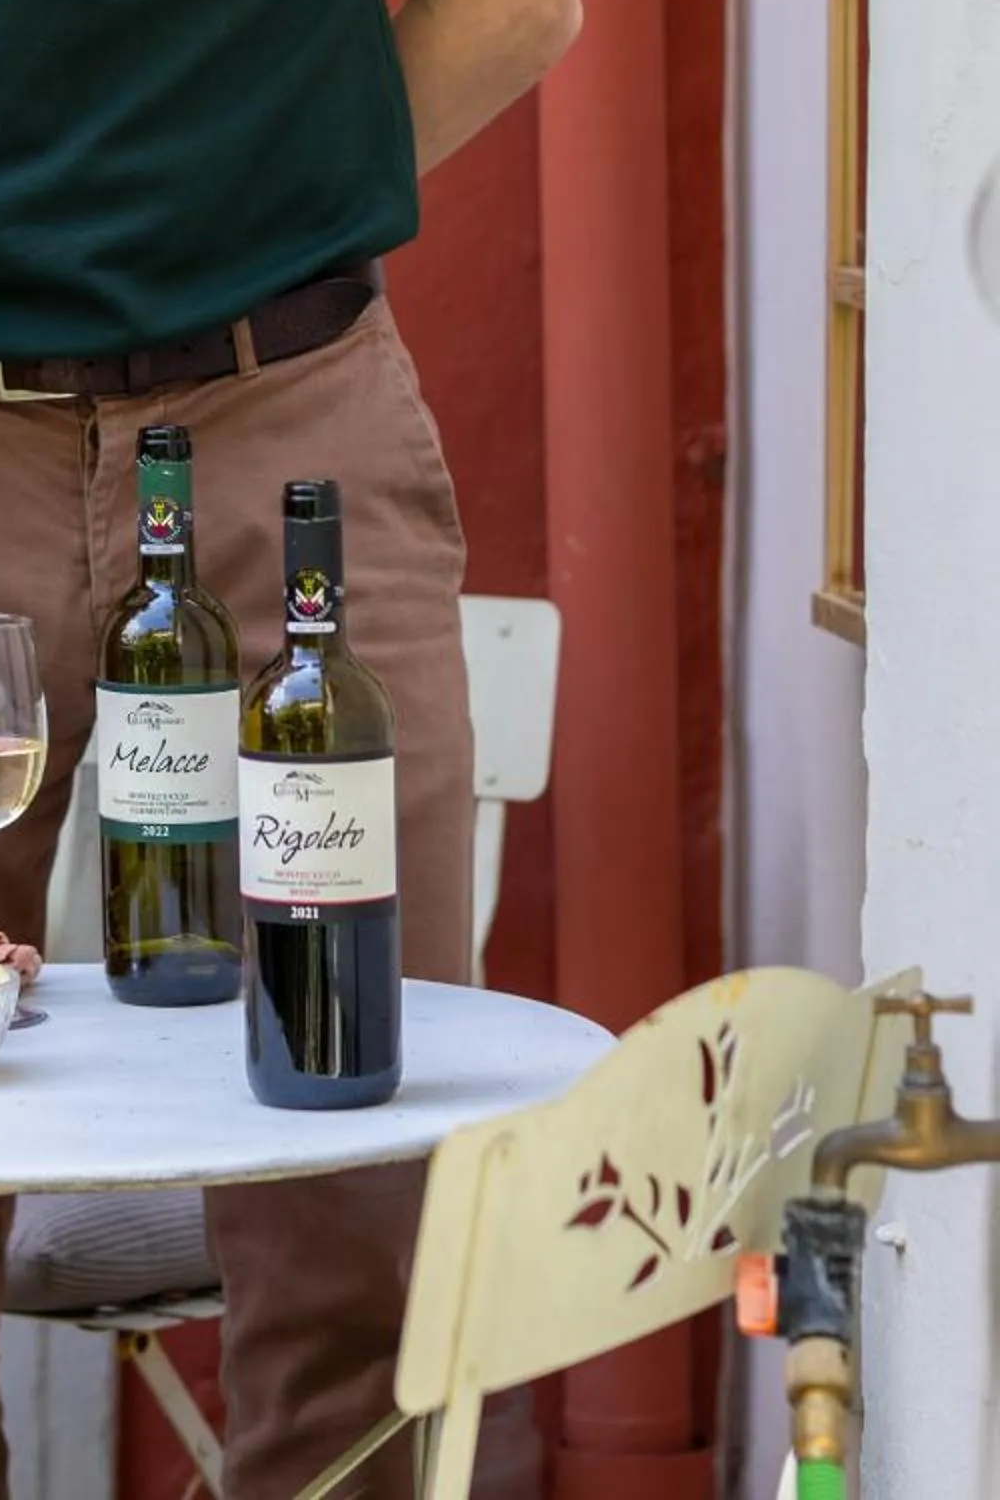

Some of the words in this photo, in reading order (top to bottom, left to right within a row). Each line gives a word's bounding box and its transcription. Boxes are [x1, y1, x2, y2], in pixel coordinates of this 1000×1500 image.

[110, 739, 209, 773] Melacce
[141, 825, 170, 837] 2022
[253, 811, 366, 865] Rigoleto
[290, 905, 320, 919] 2021
